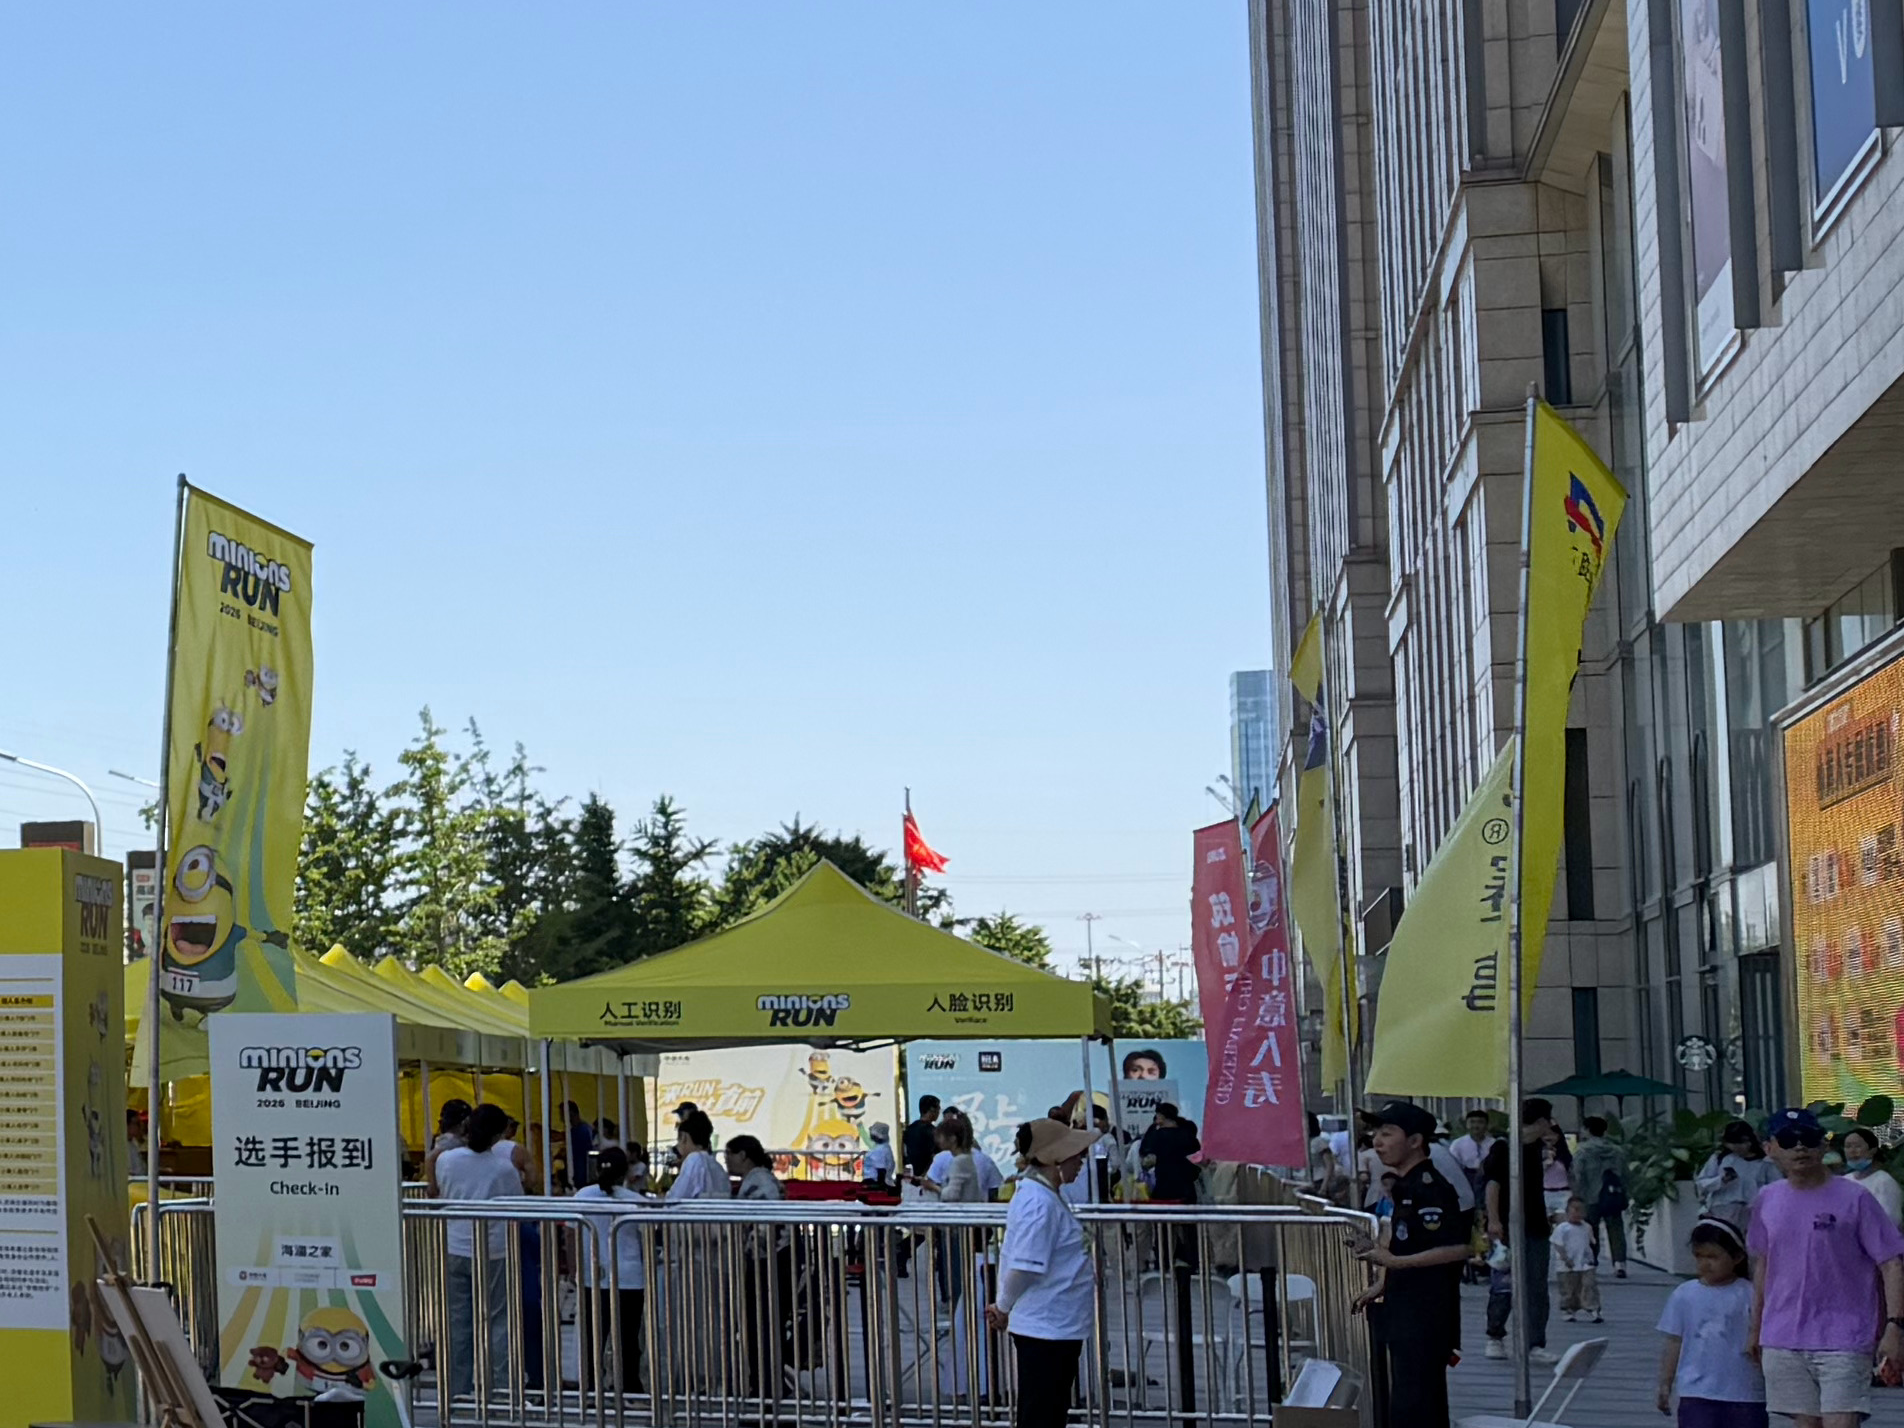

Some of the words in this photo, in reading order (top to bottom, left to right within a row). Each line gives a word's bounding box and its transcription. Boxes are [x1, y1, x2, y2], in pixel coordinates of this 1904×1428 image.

[220, 562, 280, 618] RUN
[80, 903, 110, 941] RUN
[172, 976, 193, 992] 117
[599, 1001, 681, 1020] 人工识别
[927, 992, 1014, 1013] 人脸识别
[769, 1008, 838, 1027] RUN
[257, 1066, 346, 1093] RUN
[257, 1099, 284, 1108] 2026
[295, 1099, 341, 1109] BEIJING
[234, 1135, 373, 1170] 选手报到
[270, 1181, 339, 1196] Check-in
